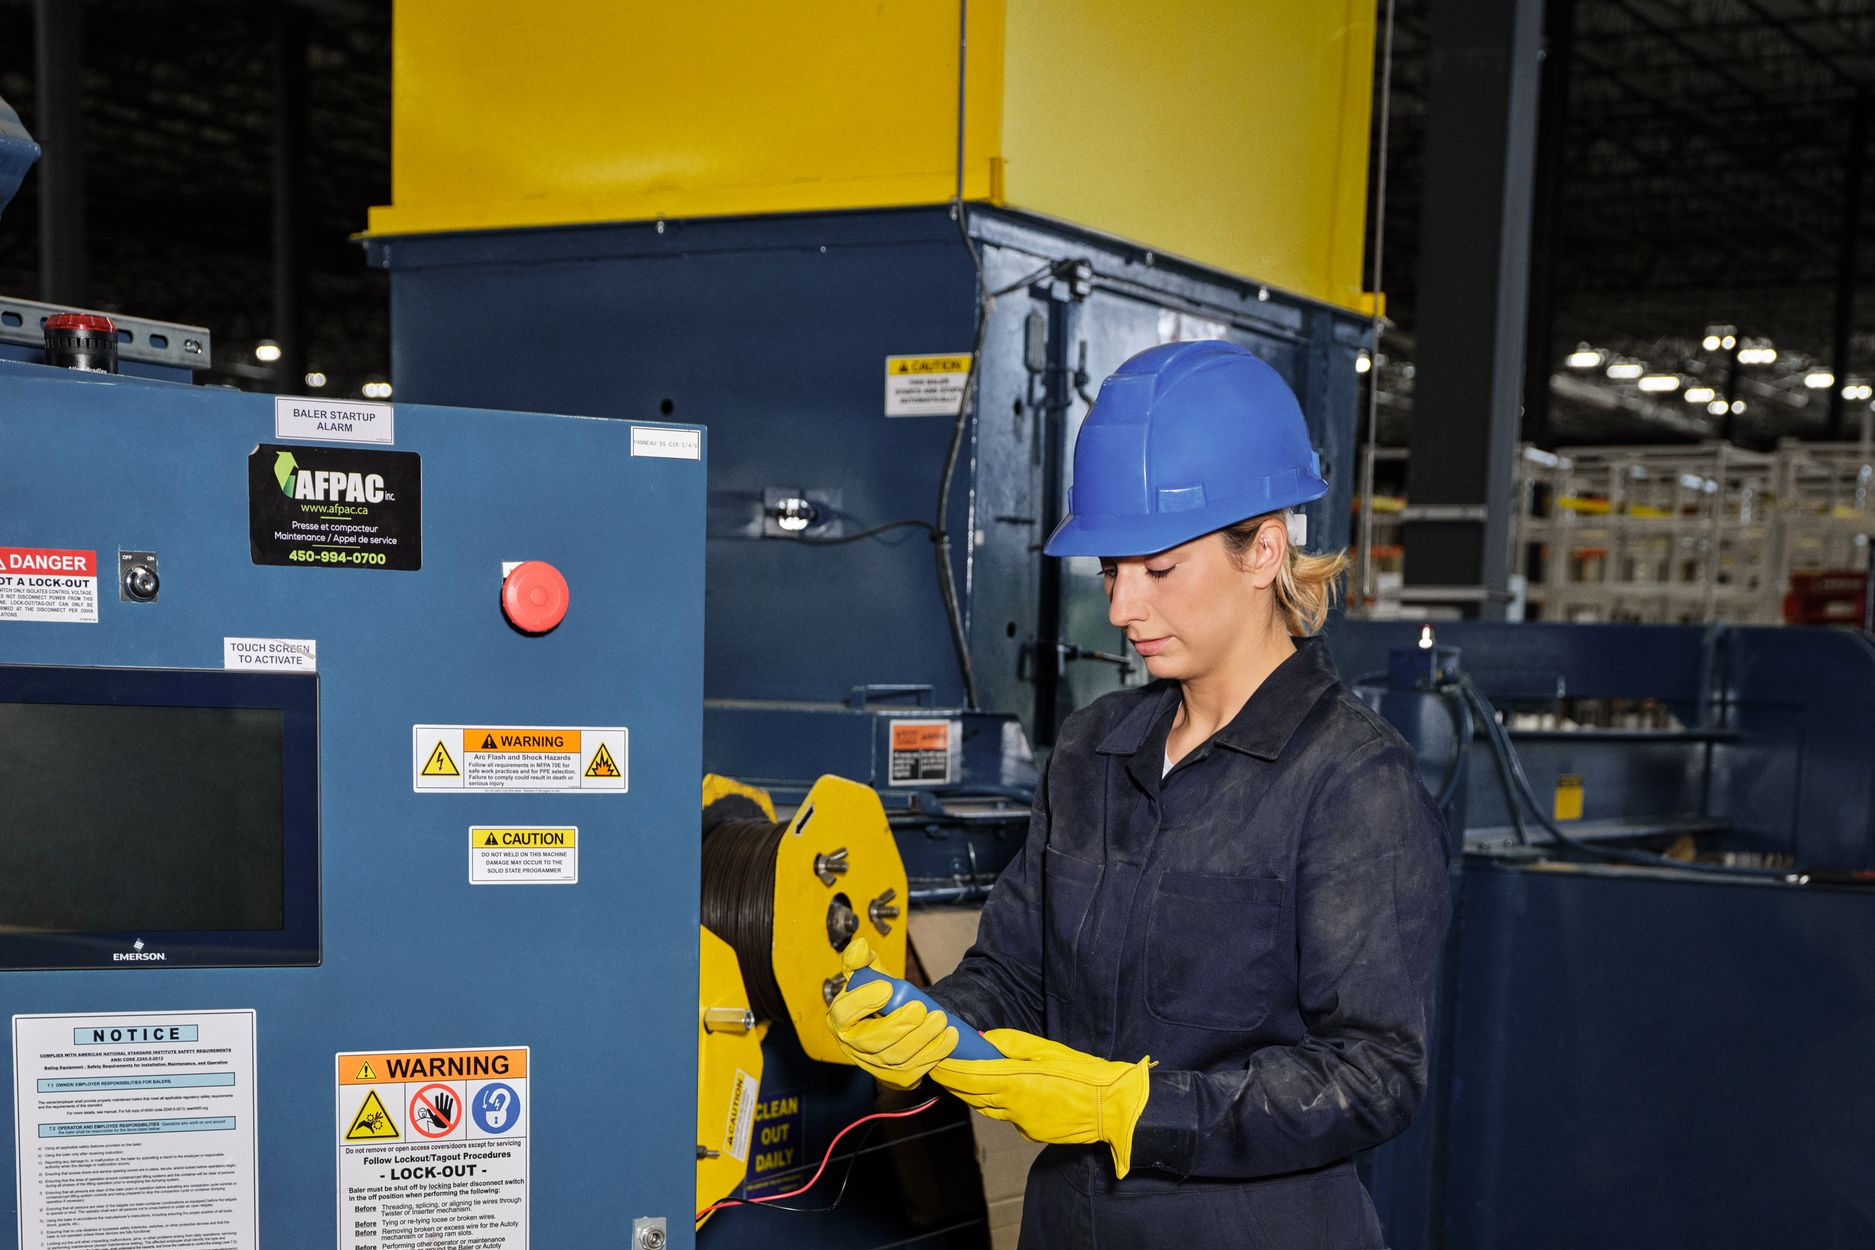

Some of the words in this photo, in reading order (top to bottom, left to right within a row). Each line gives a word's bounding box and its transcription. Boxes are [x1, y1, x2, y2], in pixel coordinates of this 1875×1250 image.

[293, 409, 327, 419] BALER
[330, 411, 376, 422] STARTUP
[317, 422, 353, 432] ALARM
[295, 470, 384, 503] AFPAC
[385, 491, 395, 501] inc.
[301, 504, 369, 515] www.afpac.ca
[292, 521, 319, 530] Presse
[320, 522, 329, 531] et
[330, 523, 378, 535] compacteur
[274, 532, 326, 541] Maintenance
[333, 534, 357, 545] Appel
[358, 535, 369, 543] de
[370, 536, 397, 545] service
[10, 554, 87, 571] DANGER
[289, 550, 387, 564] 450-994-0700
[17, 578, 25, 586] A
[29, 578, 90, 588] LOCK-OUT
[230, 643, 266, 652] TOUCH
[269, 644, 310, 653] SCREEN
[240, 654, 252, 663] TO
[255, 655, 303, 664] ACTIVATE
[501, 736, 564, 748] WARNING
[502, 833, 564, 845] CAUTION
[93, 1028, 180, 1042] NOTICE
[386, 1055, 509, 1078] WARNING
[728, 1078, 743, 1134] CAUTION
[755, 1097, 798, 1121] CLEAN
[761, 1124, 790, 1146] OUT
[431, 1142, 467, 1150] covers/doors
[468, 1141, 487, 1150] except
[496, 1139, 522, 1148] servicing
[363, 1157, 392, 1165] Follow
[394, 1153, 461, 1165] Lockout/Tagout
[463, 1150, 511, 1160] Procedures
[755, 1148, 794, 1172] DAILY
[391, 1164, 477, 1181] LOCK-OUT
[419, 1183, 427, 1191] by
[428, 1182, 452, 1191] locking
[469, 1179, 504, 1187] disconnect
[378, 1192, 404, 1201] position
[423, 1189, 458, 1198] performing
[470, 1187, 501, 1196] following:
[354, 1205, 377, 1213] Before
[382, 1203, 415, 1212] Threading,
[415, 1201, 439, 1210] splicing,
[449, 1199, 473, 1208] aligning
[499, 1196, 522, 1205] through
[354, 1220, 377, 1228] Before
[382, 1219, 399, 1227] Tying
[407, 1217, 431, 1226] re-tying
